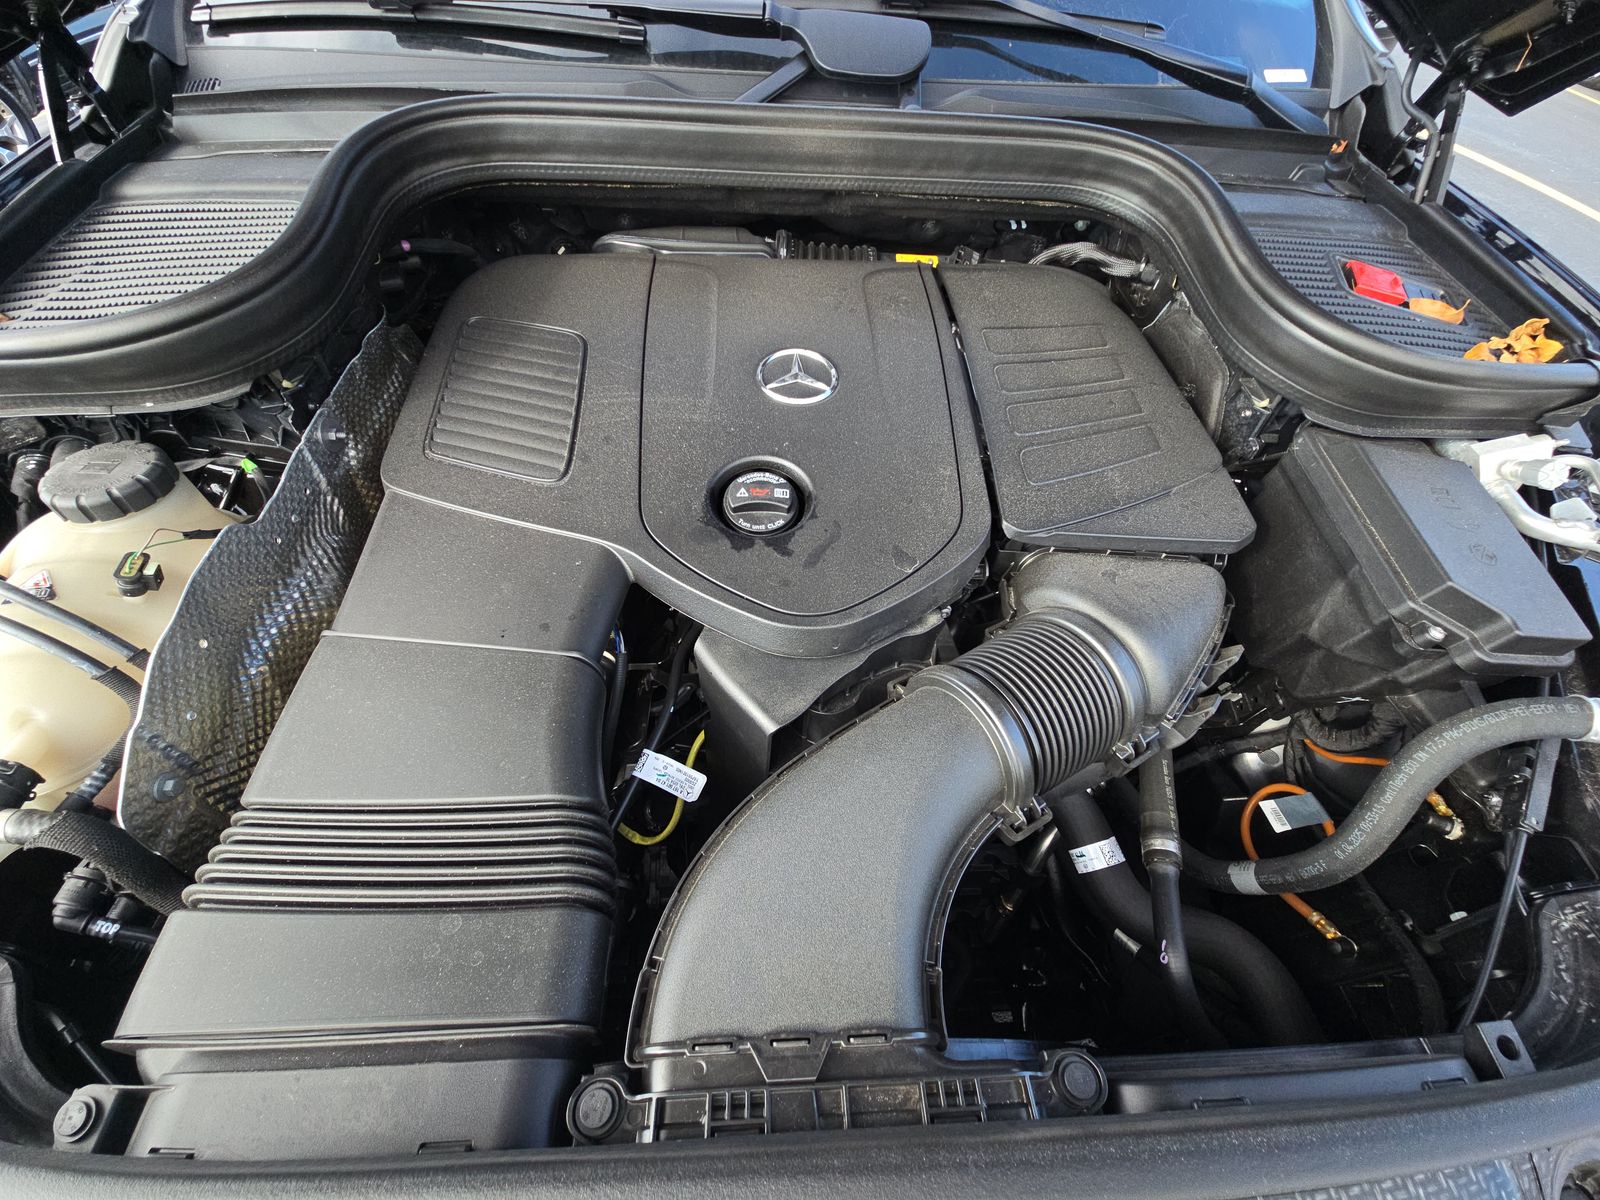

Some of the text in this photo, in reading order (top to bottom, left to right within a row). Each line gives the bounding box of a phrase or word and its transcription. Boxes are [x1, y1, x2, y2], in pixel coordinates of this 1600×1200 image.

[736, 472, 780, 483] Mercedes-Benz
[738, 518, 751, 528] Turn
[767, 518, 785, 529] CLICK
[1381, 773, 1408, 804] ContiTech
[95, 919, 121, 935] TOP
